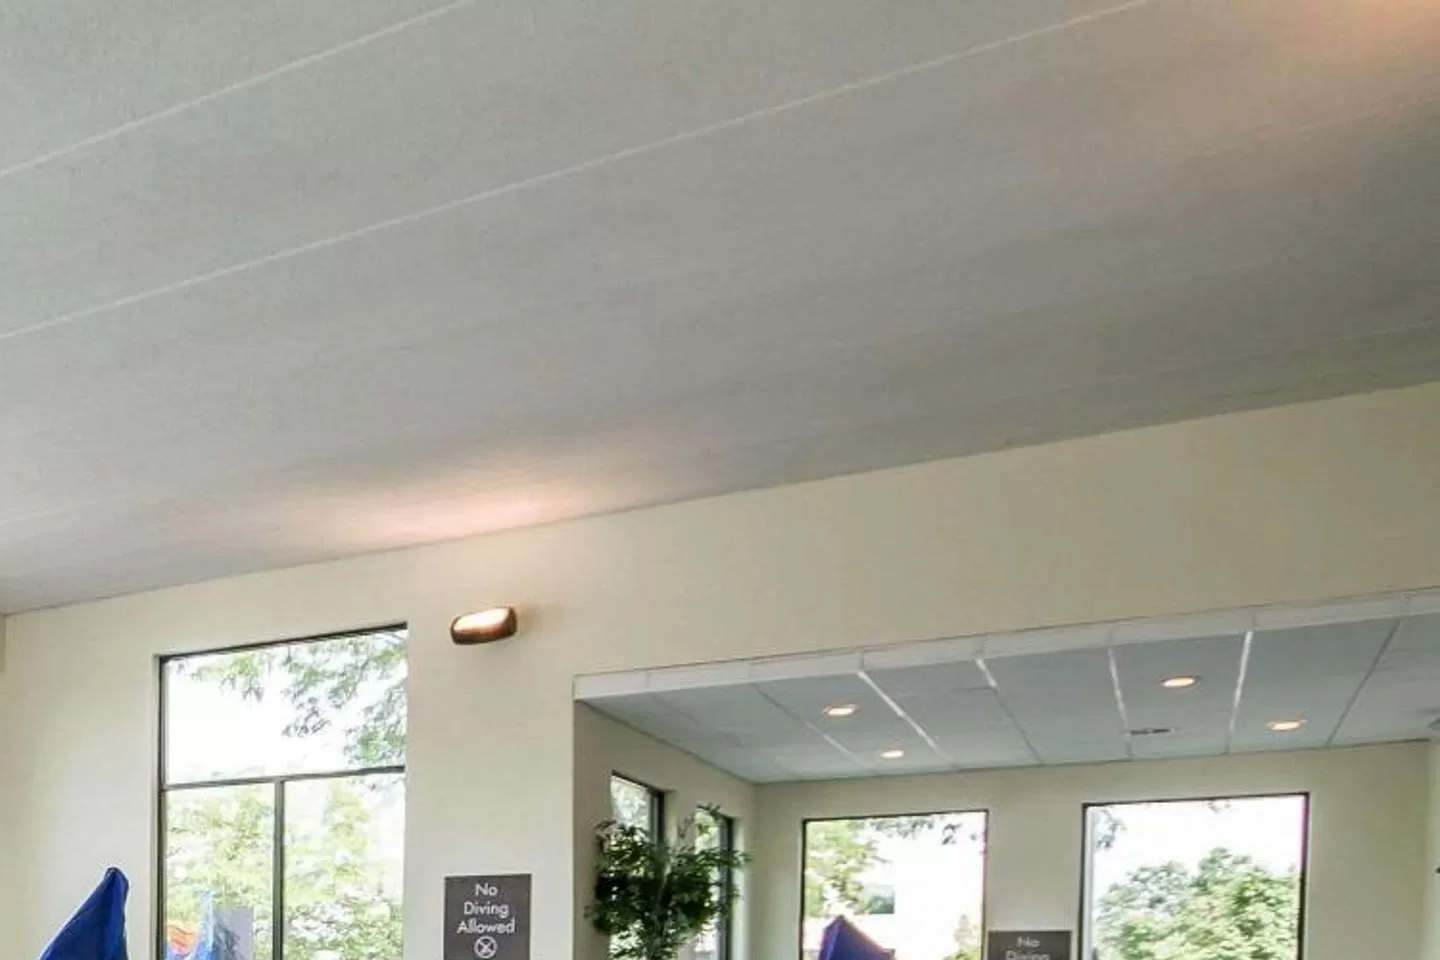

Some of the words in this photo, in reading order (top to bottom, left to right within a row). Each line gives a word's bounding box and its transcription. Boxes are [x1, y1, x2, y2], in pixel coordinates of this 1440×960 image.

[475, 882, 498, 896] No
[463, 901, 508, 918] Diving
[456, 917, 515, 934] Allowed
[1017, 936, 1040, 948] No
